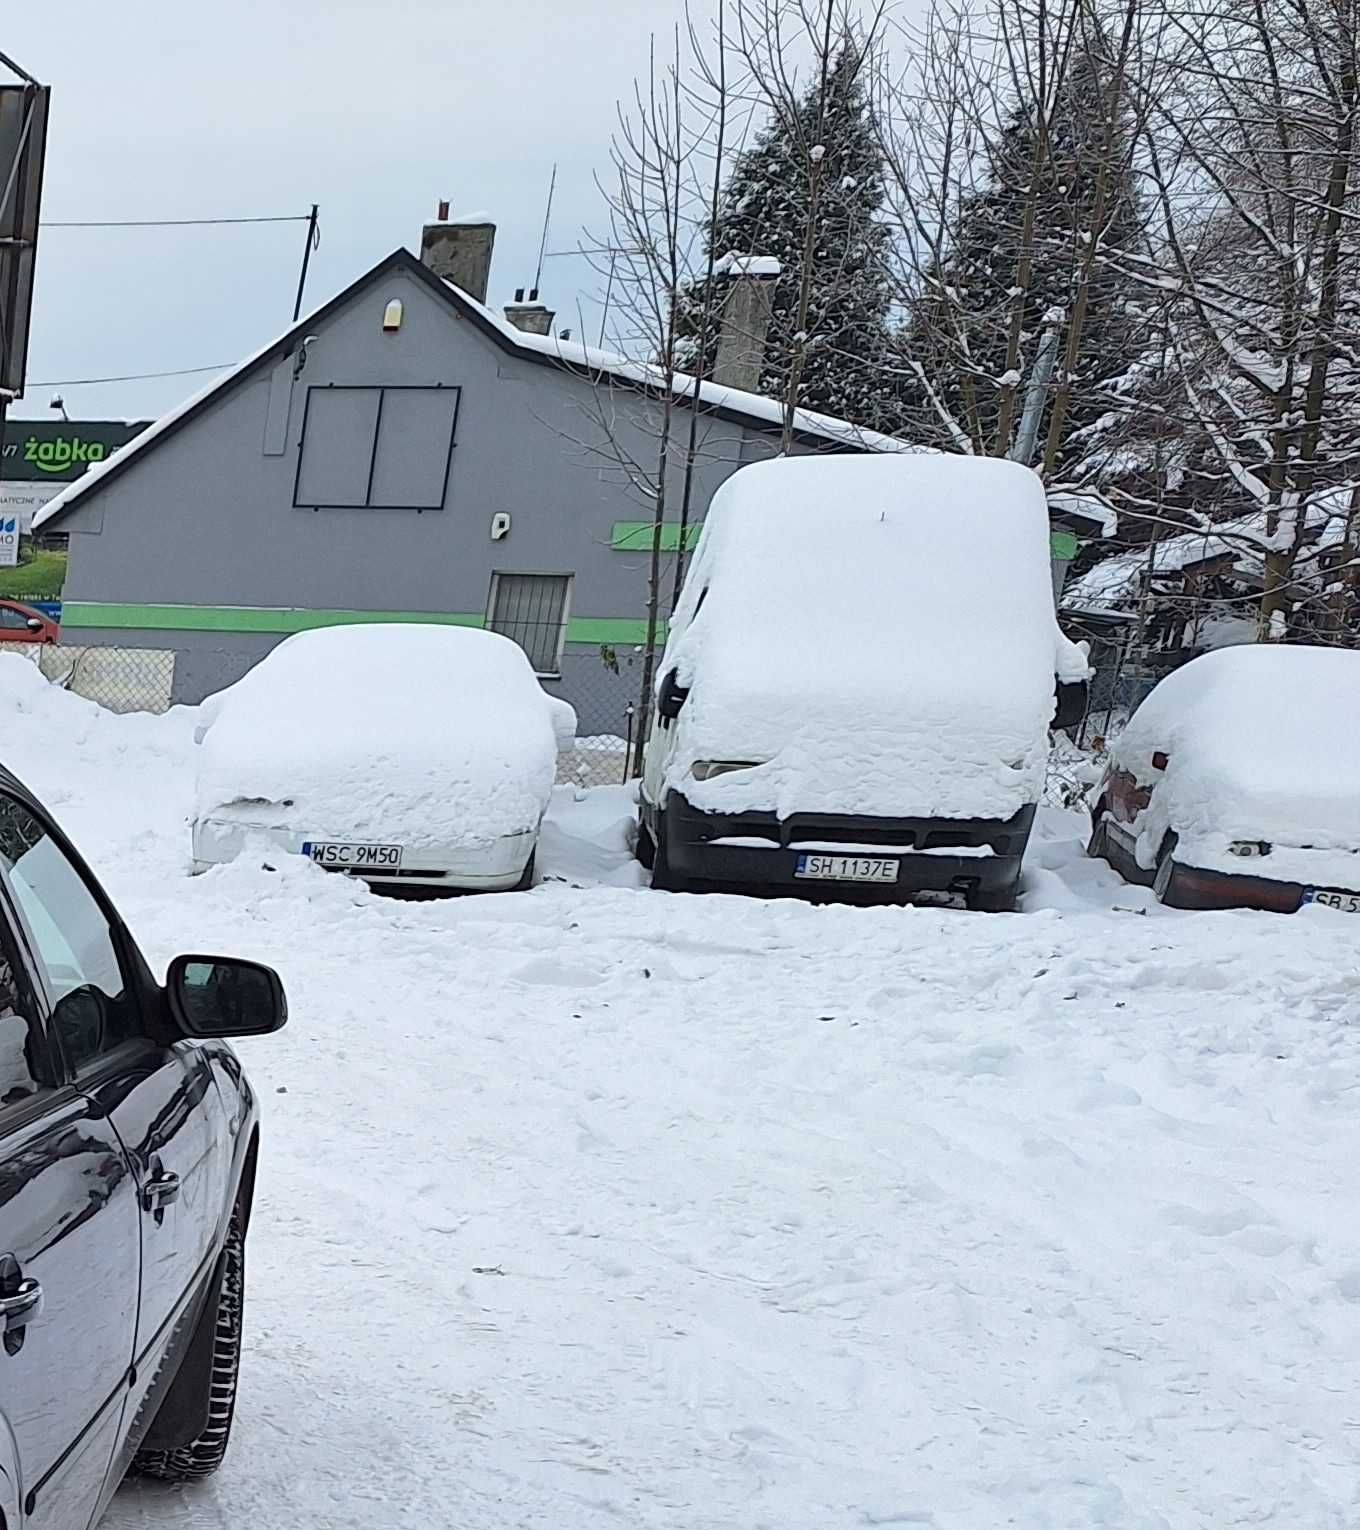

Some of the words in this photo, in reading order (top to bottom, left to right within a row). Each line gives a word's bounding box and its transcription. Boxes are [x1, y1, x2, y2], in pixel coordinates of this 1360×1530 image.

[23, 437, 104, 461] żabka
[313, 844, 351, 862] WSC
[356, 846, 399, 863] 9M50
[809, 858, 833, 873] SH
[841, 860, 895, 877] 1137E
